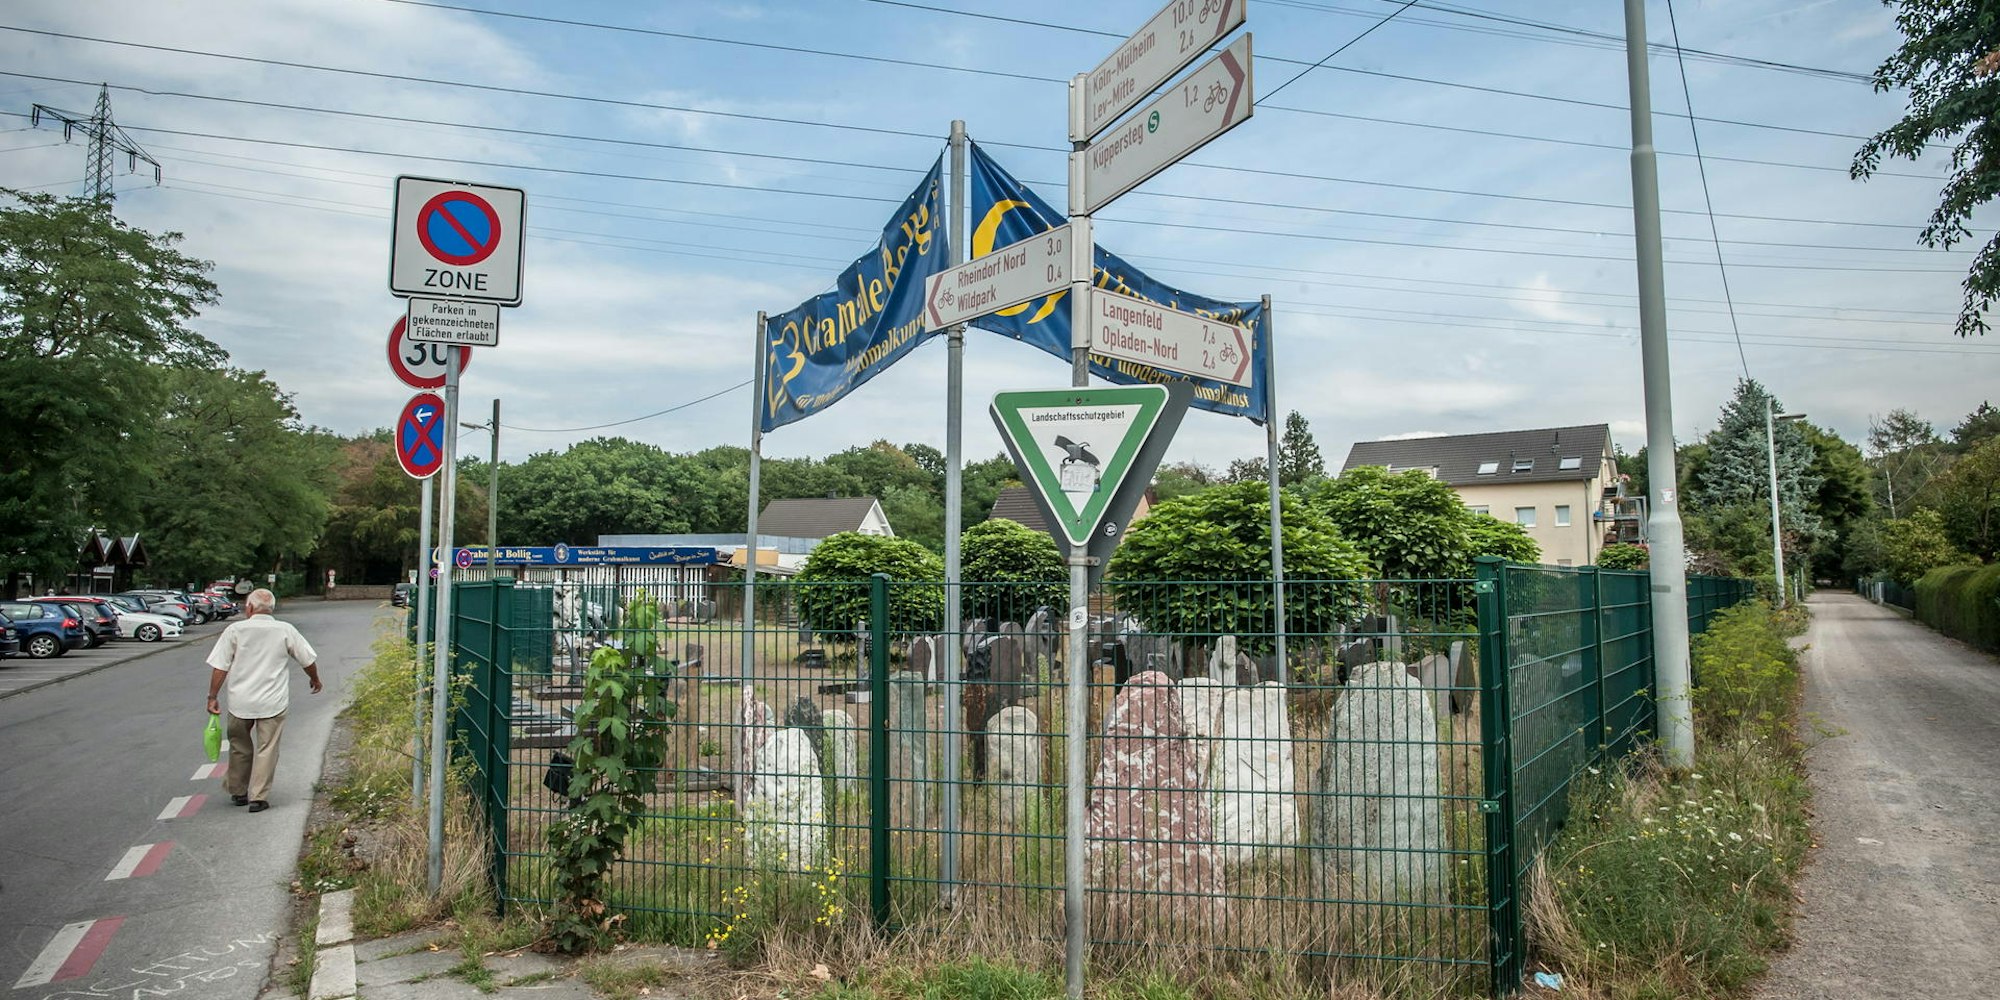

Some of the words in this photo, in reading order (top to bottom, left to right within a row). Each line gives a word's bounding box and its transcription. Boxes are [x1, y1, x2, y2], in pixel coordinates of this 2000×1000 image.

[1093, 32, 1155, 95] Köln-Mülheim
[1093, 77, 1135, 122] Lev-Mitte
[1179, 28, 1194, 53] 2,6
[1093, 123, 1144, 170] Küppersteg
[1184, 85, 1199, 108] 1,2
[424, 268, 489, 291] ZONE
[957, 257, 1001, 289] Rheindorf
[1003, 247, 1026, 273] Nord
[1047, 237, 1062, 257] 3,0
[432, 303, 464, 315] Parken
[468, 305, 477, 316] in
[957, 284, 997, 313] Wildpark
[1047, 264, 1062, 283] 0,4
[412, 314, 495, 330] gekennzeichneten
[416, 326, 452, 339] Flächen
[456, 331, 489, 341] erlaubt
[1102, 297, 1163, 331] Langenfeld
[1203, 324, 1216, 345] 7,6
[1102, 325, 1178, 361] Opladen-Nord
[1203, 349, 1216, 370] 2,6
[1031, 410, 1125, 422] Landschaftsschutzgebiet
[505, 549, 532, 560] Bollig
